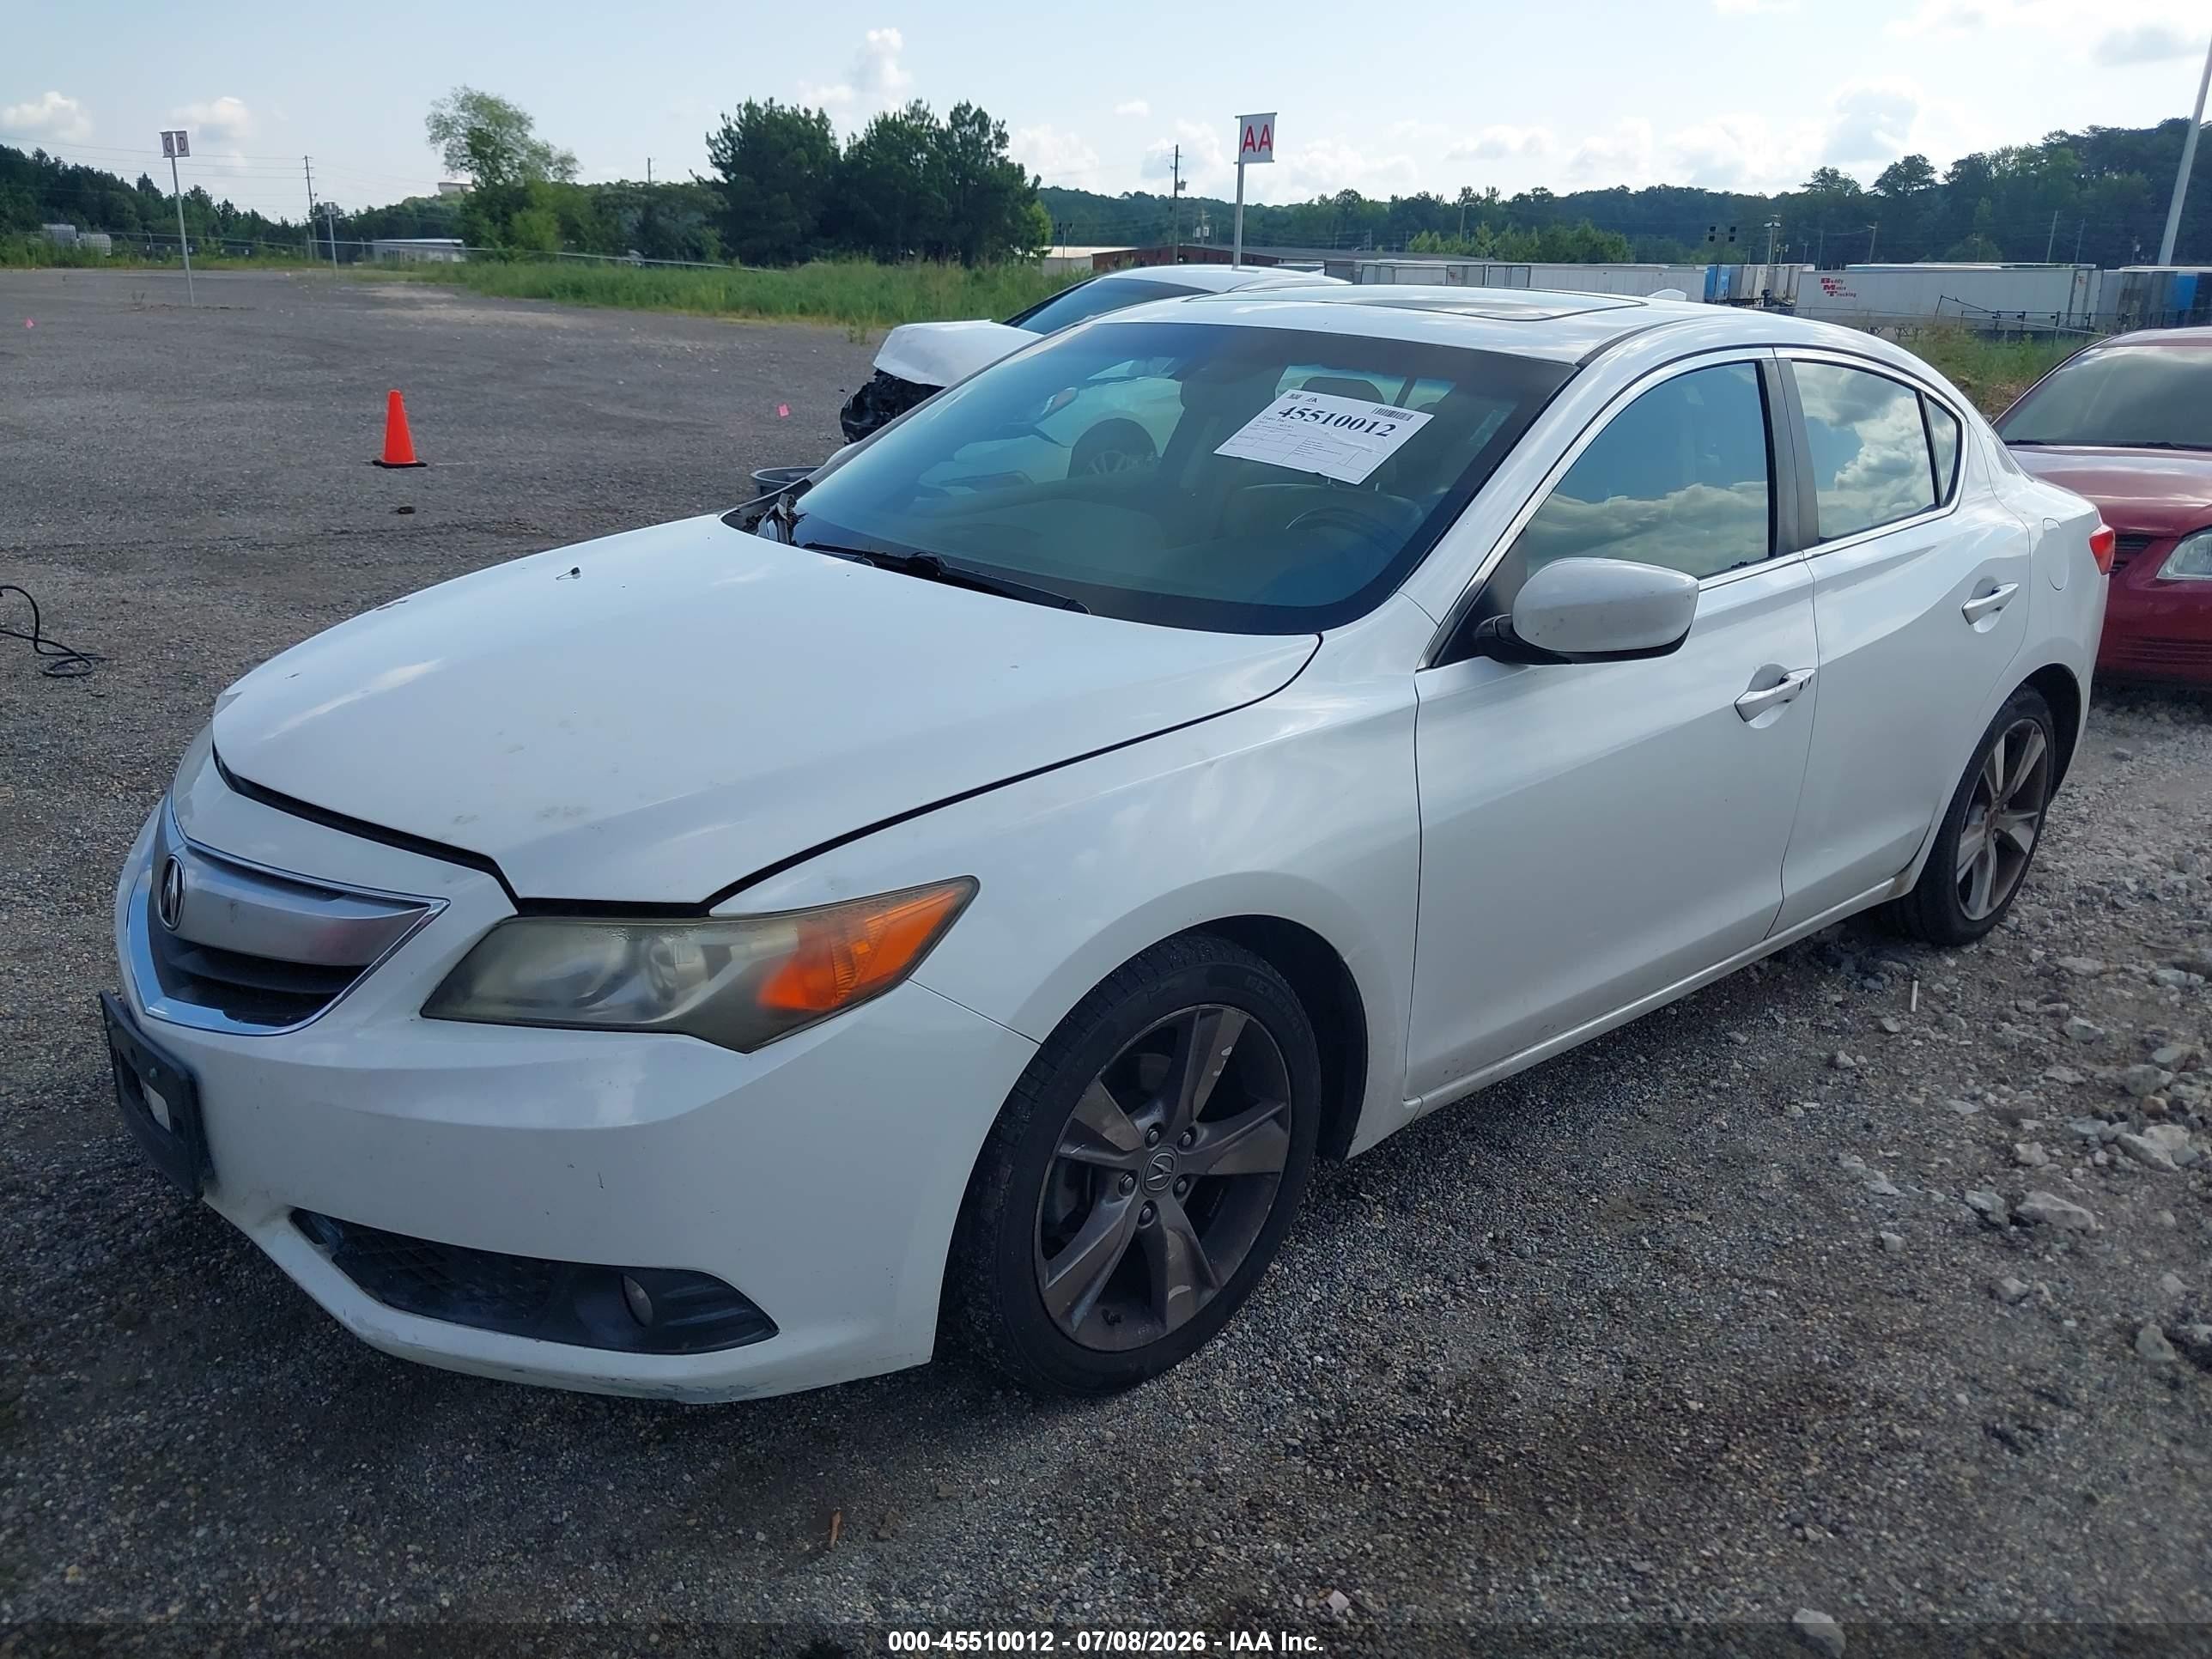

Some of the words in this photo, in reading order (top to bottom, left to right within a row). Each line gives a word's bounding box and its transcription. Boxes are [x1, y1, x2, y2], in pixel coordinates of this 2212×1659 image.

[179, 137, 186, 152] D
[1242, 125, 1272, 153] AA
[1278, 405, 1396, 437] 45510012
